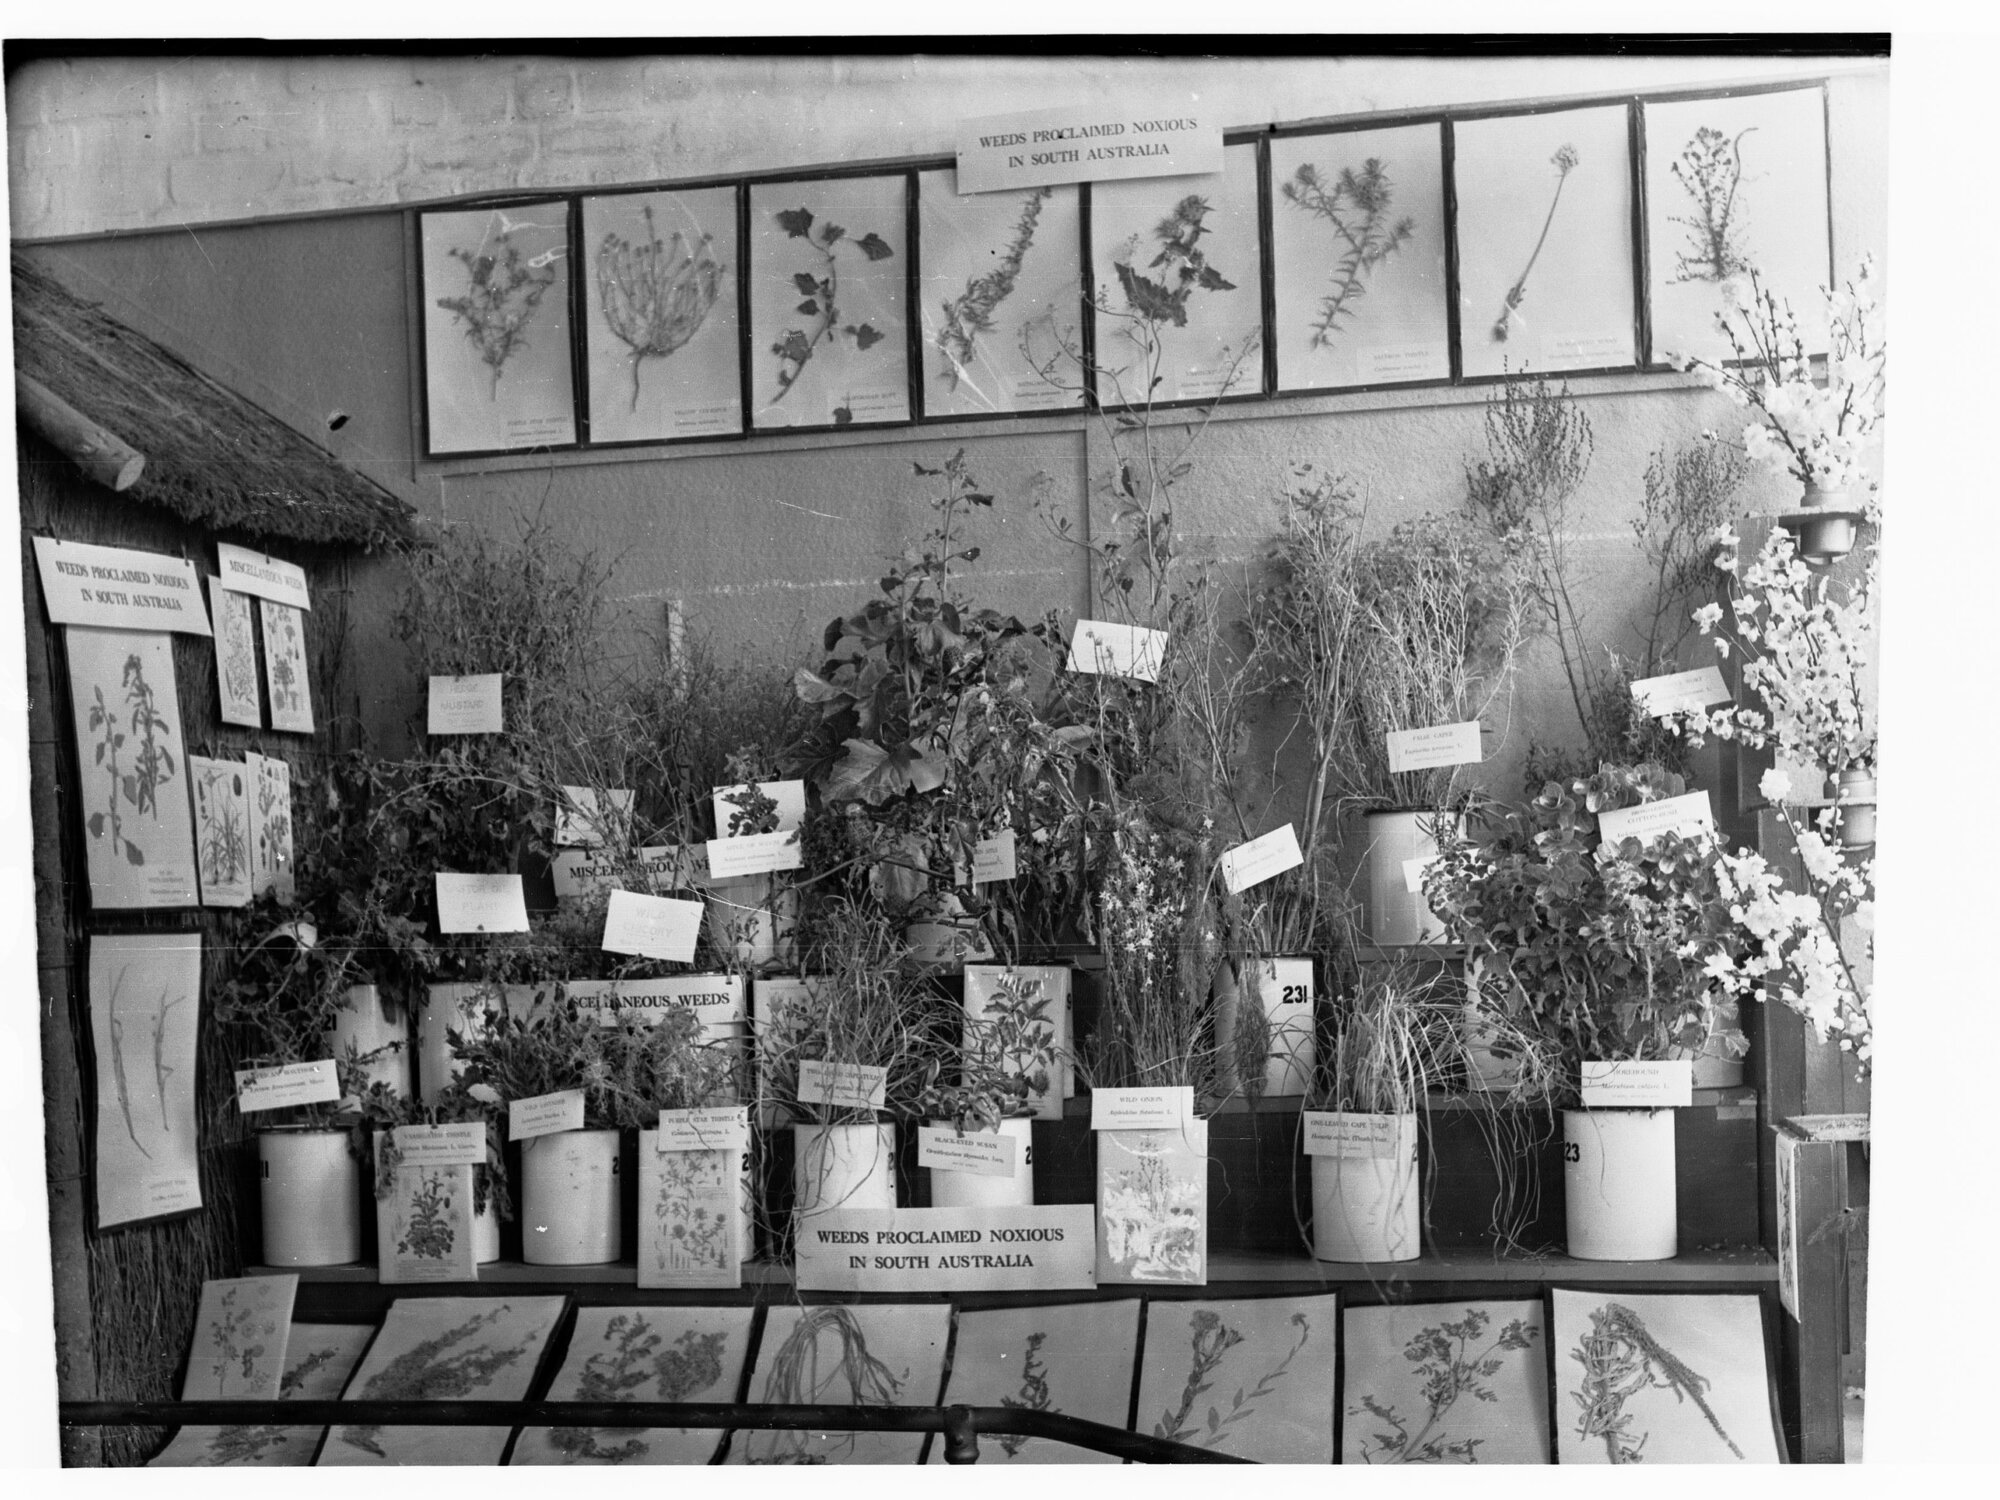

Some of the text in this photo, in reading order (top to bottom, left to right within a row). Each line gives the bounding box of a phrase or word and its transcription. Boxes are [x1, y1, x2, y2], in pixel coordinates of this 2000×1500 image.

[980, 118, 1198, 148] WEEDS PROCLAIMED NOXIOUS
[1008, 143, 1170, 168] IN SOUTH AUSTRALIA
[56, 560, 190, 590] WEEDS PROCLAIMED NOXIOUS
[80, 588, 183, 611] IN SOUTH AUSTRALIA
[678, 992, 730, 1007] WEEDS
[1282, 985, 1308, 1004] 231
[742, 1152, 750, 1172] 2
[1025, 1145, 1032, 1165] 2
[1563, 1141, 1580, 1163] 23
[612, 1155, 620, 1175] 2
[817, 1227, 1064, 1244] WEEDS PROCLAIMED NOXIOUS
[850, 1253, 1033, 1269] IN SOUTH AUSTRALIA
